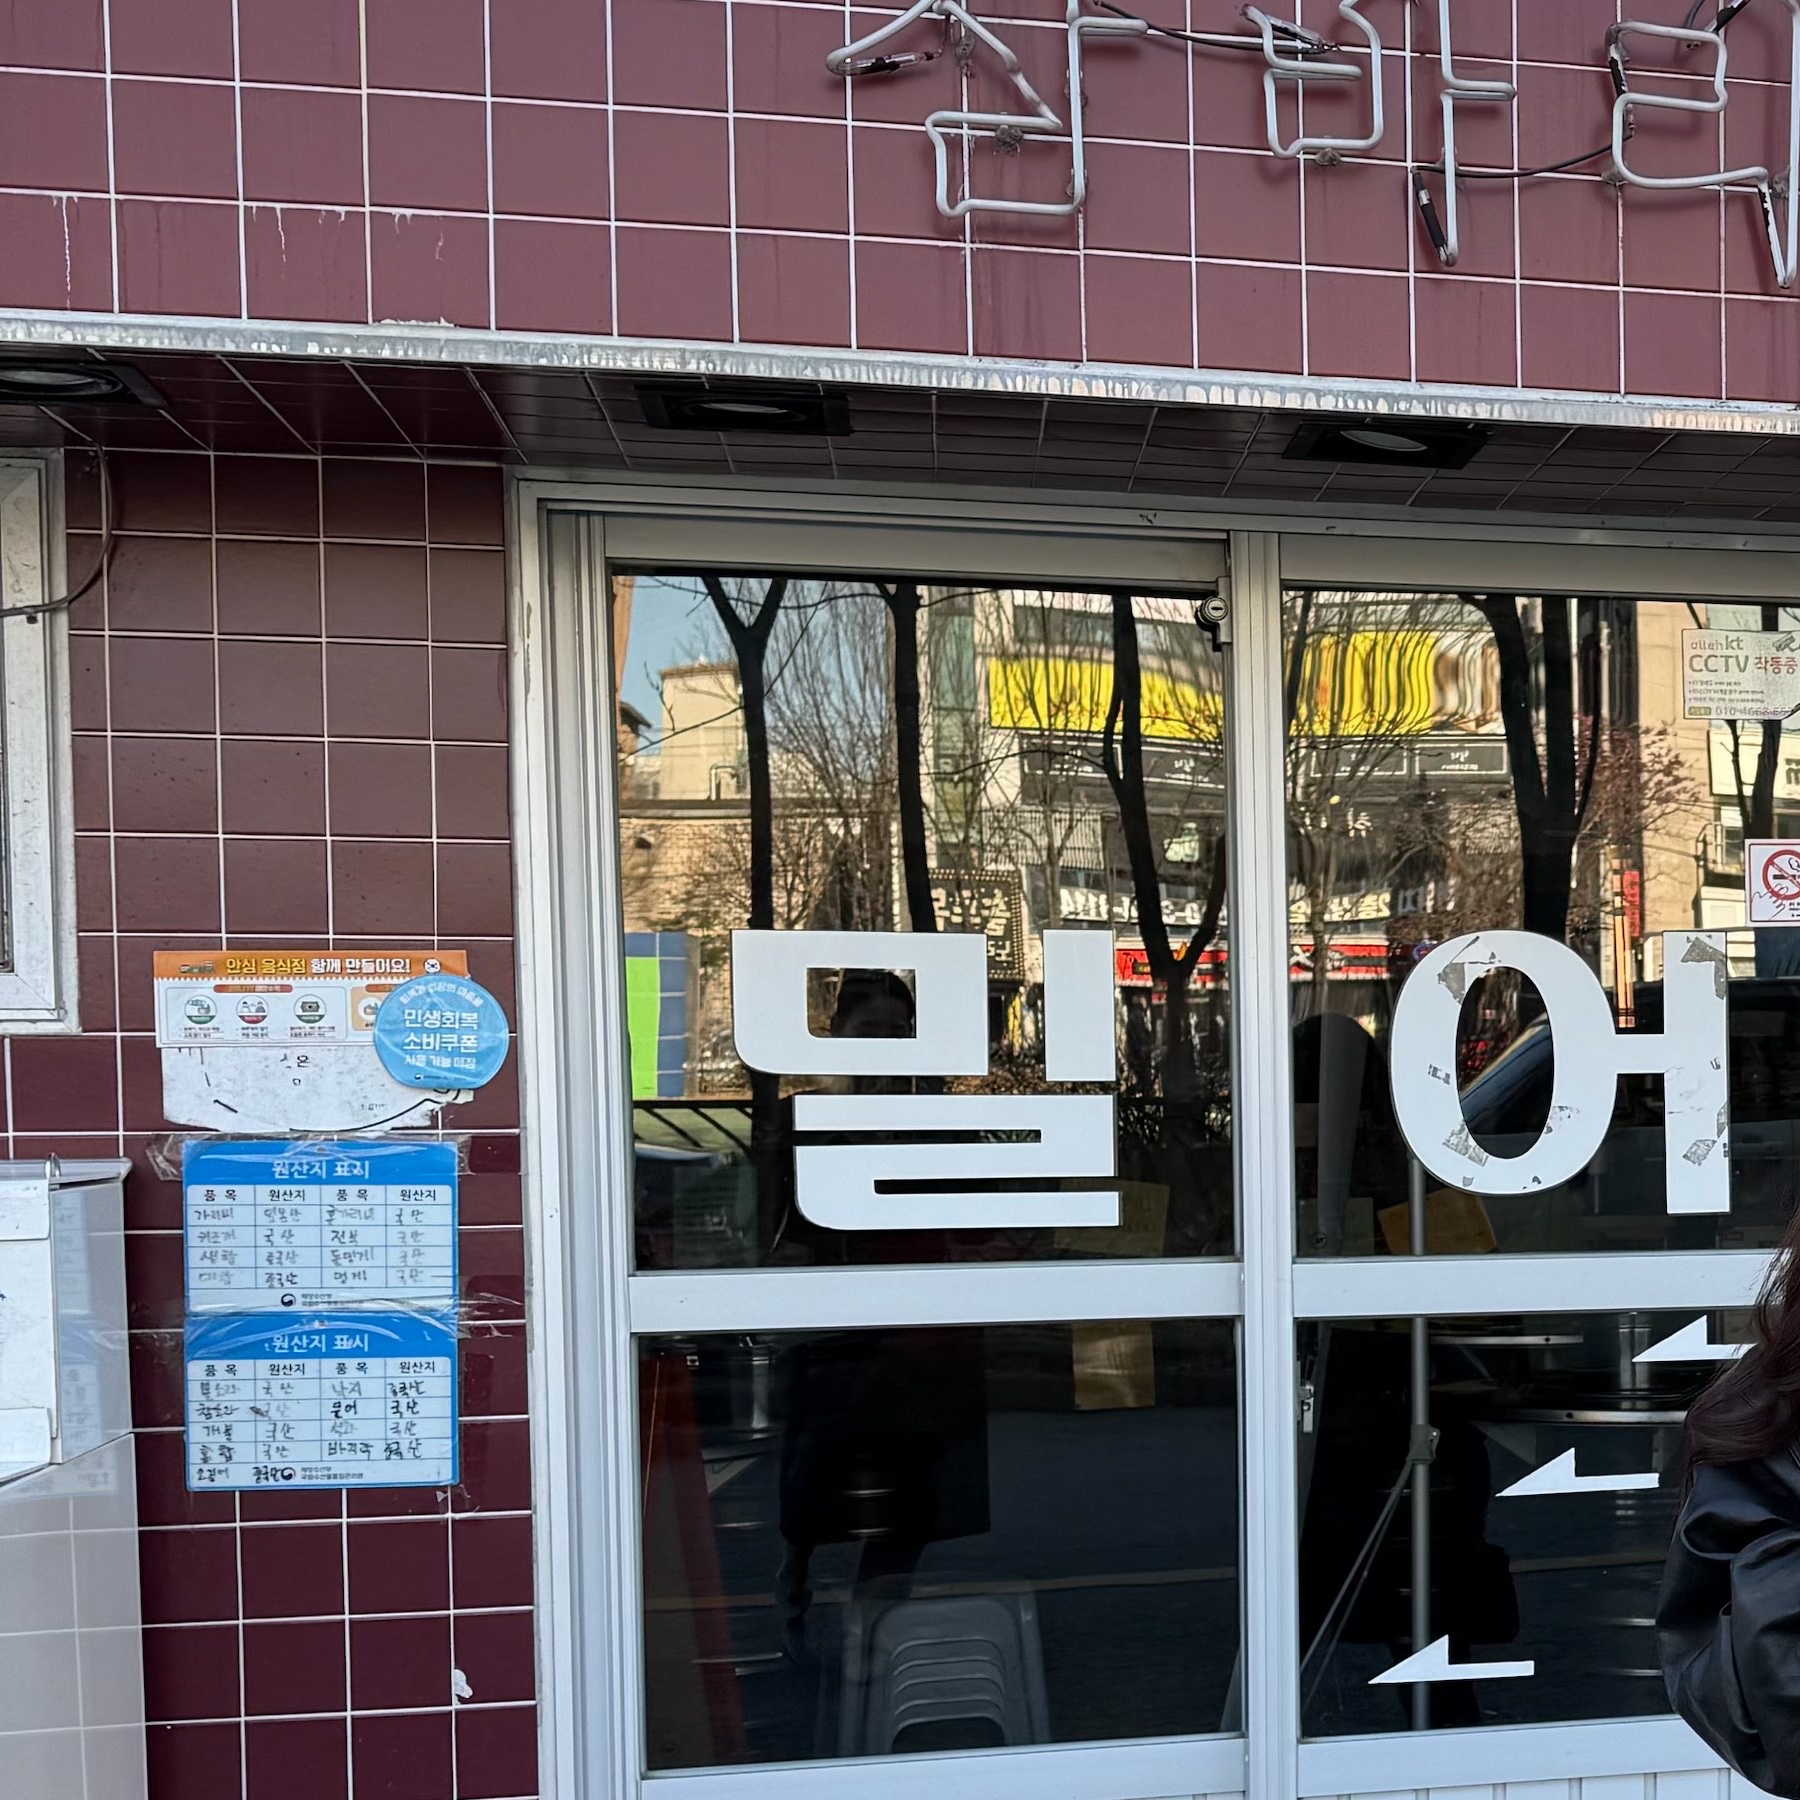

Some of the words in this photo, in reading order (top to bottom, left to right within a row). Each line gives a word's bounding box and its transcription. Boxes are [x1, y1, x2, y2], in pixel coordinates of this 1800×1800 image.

[1688, 654, 1749, 673] CCTV
[1754, 655, 1798, 675] 작동중
[226, 959, 258, 974] 안심
[261, 959, 306, 975] 음식점
[310, 959, 341, 974] 함께
[345, 959, 411, 974] 만들어요!
[403, 1009, 479, 1030] 민생회복
[402, 1032, 479, 1053] 소비쿠폰
[271, 1160, 327, 1180] 원산지
[268, 1189, 306, 1201] 원산지
[399, 1188, 436, 1201] 원산지
[263, 1228, 295, 1247] 국산
[272, 1333, 327, 1353] 원산지
[332, 1334, 369, 1352] 표시
[269, 1364, 306, 1376] 원산지
[398, 1360, 436, 1374] 원산지
[330, 1399, 358, 1419] 문어
[390, 1398, 419, 1419] 국산
[328, 1441, 373, 1461] 바지락
